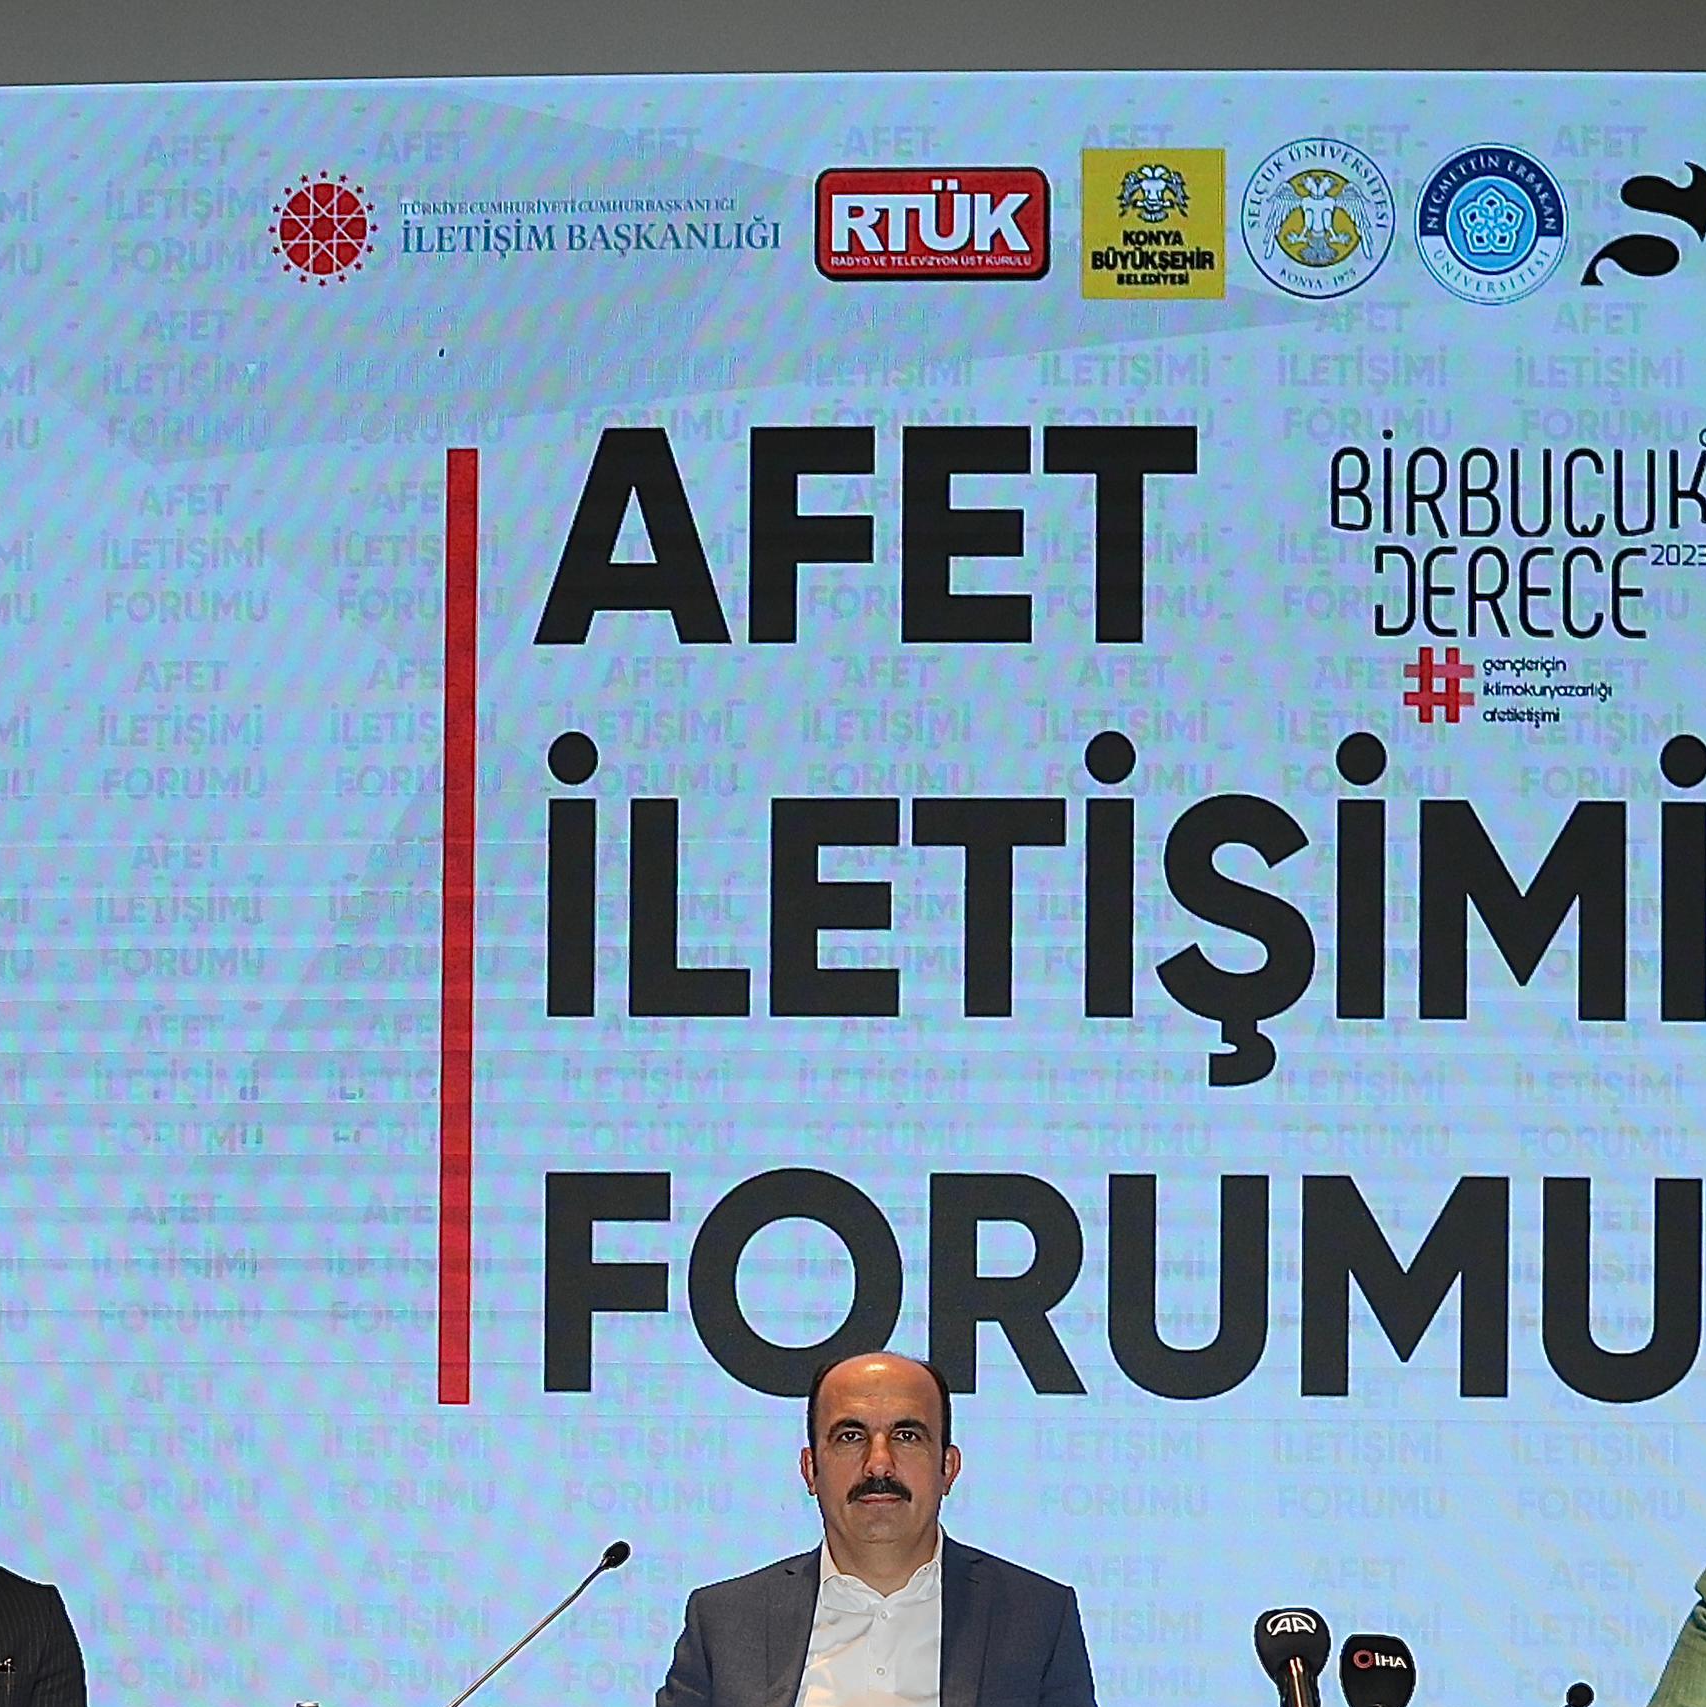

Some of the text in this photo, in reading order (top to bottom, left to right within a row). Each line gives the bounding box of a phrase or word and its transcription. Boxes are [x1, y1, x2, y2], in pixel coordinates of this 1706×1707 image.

[831, 178, 1031, 252] RTÜK
[1247, 157, 1285, 230] SELÇUK
[1426, 153, 1558, 231] NECMETTİN ERBAKAN
[400, 215, 783, 258] İLETİŞİM BAŞKANLIĞI
[831, 256, 871, 267] RADYO
[873, 256, 887, 267] VE
[1091, 247, 1215, 273] BÜYÜKŞEHİR
[1122, 230, 1184, 247] KONYA
[533, 427, 1198, 644] AFET
[543, 1167, 1704, 1401] FORUMU
[1374, 1651, 1408, 1670] İHA
